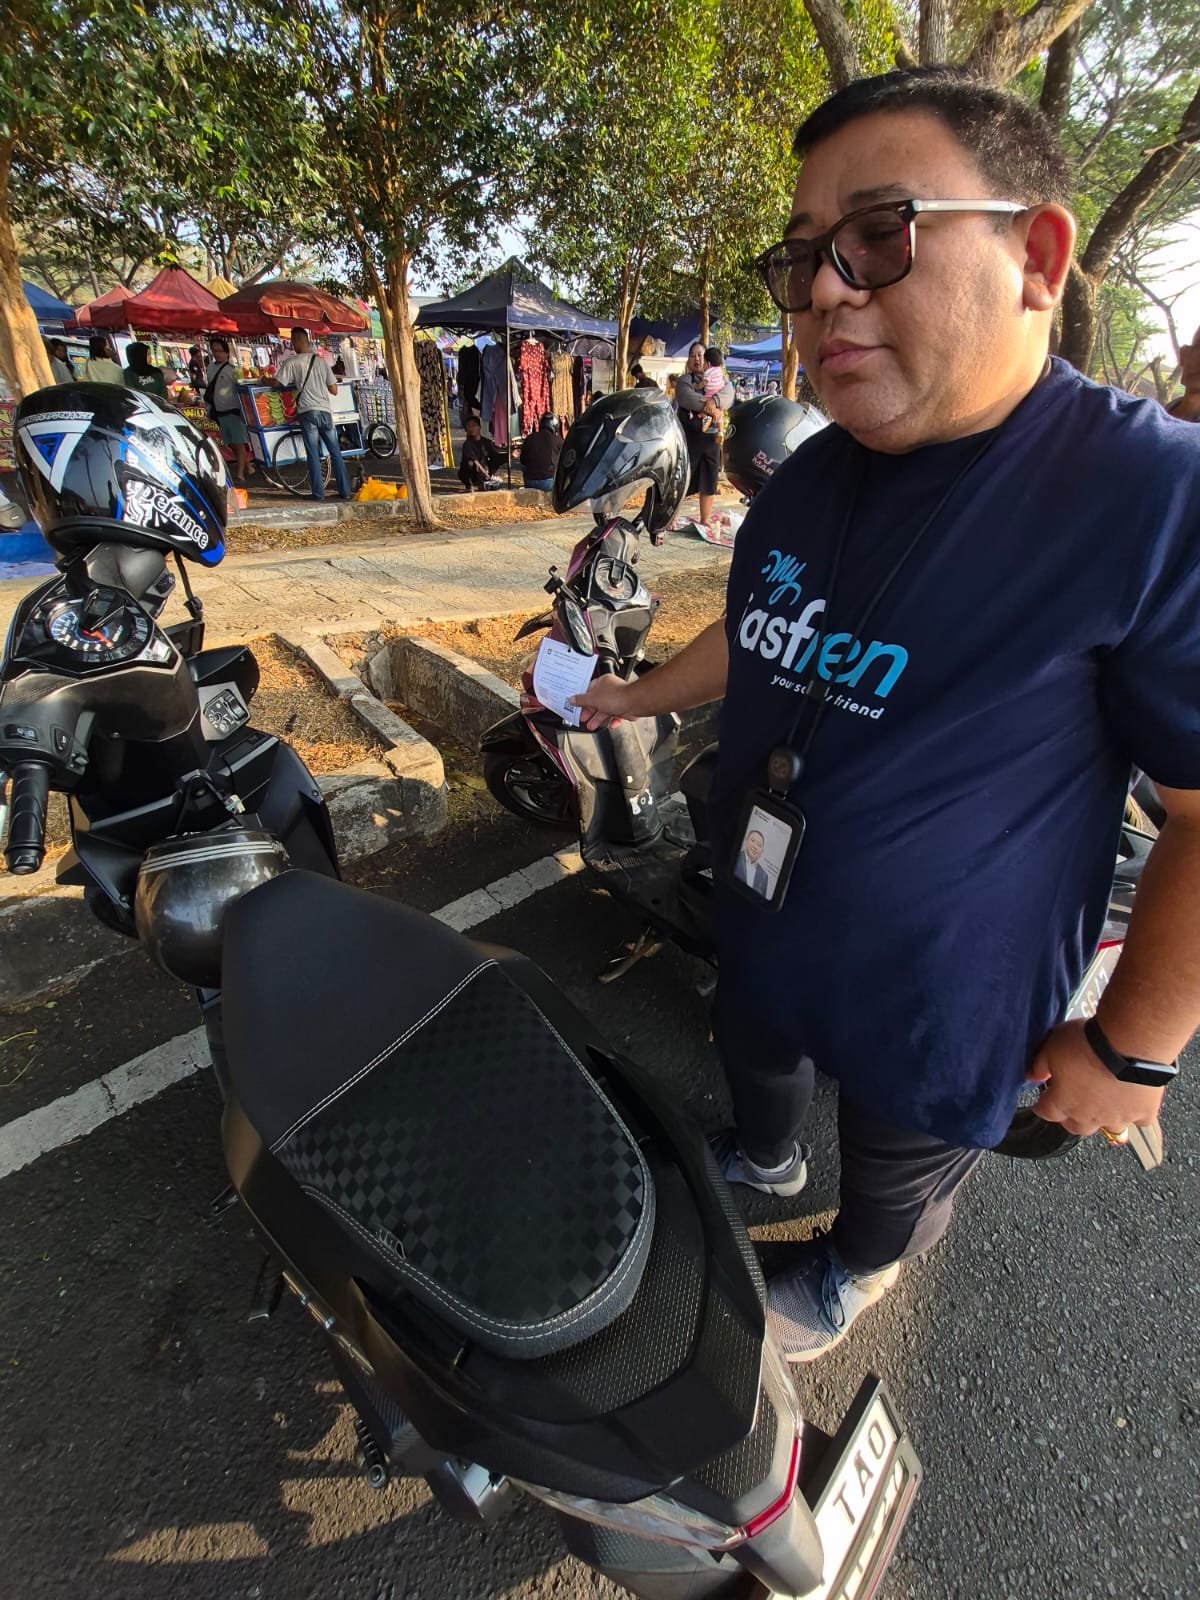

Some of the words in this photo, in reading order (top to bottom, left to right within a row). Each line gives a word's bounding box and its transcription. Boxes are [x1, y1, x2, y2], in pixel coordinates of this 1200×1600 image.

[734, 592, 909, 698] asfren
[834, 694, 886, 720] friend
[833, 1418, 887, 1526] TAO
